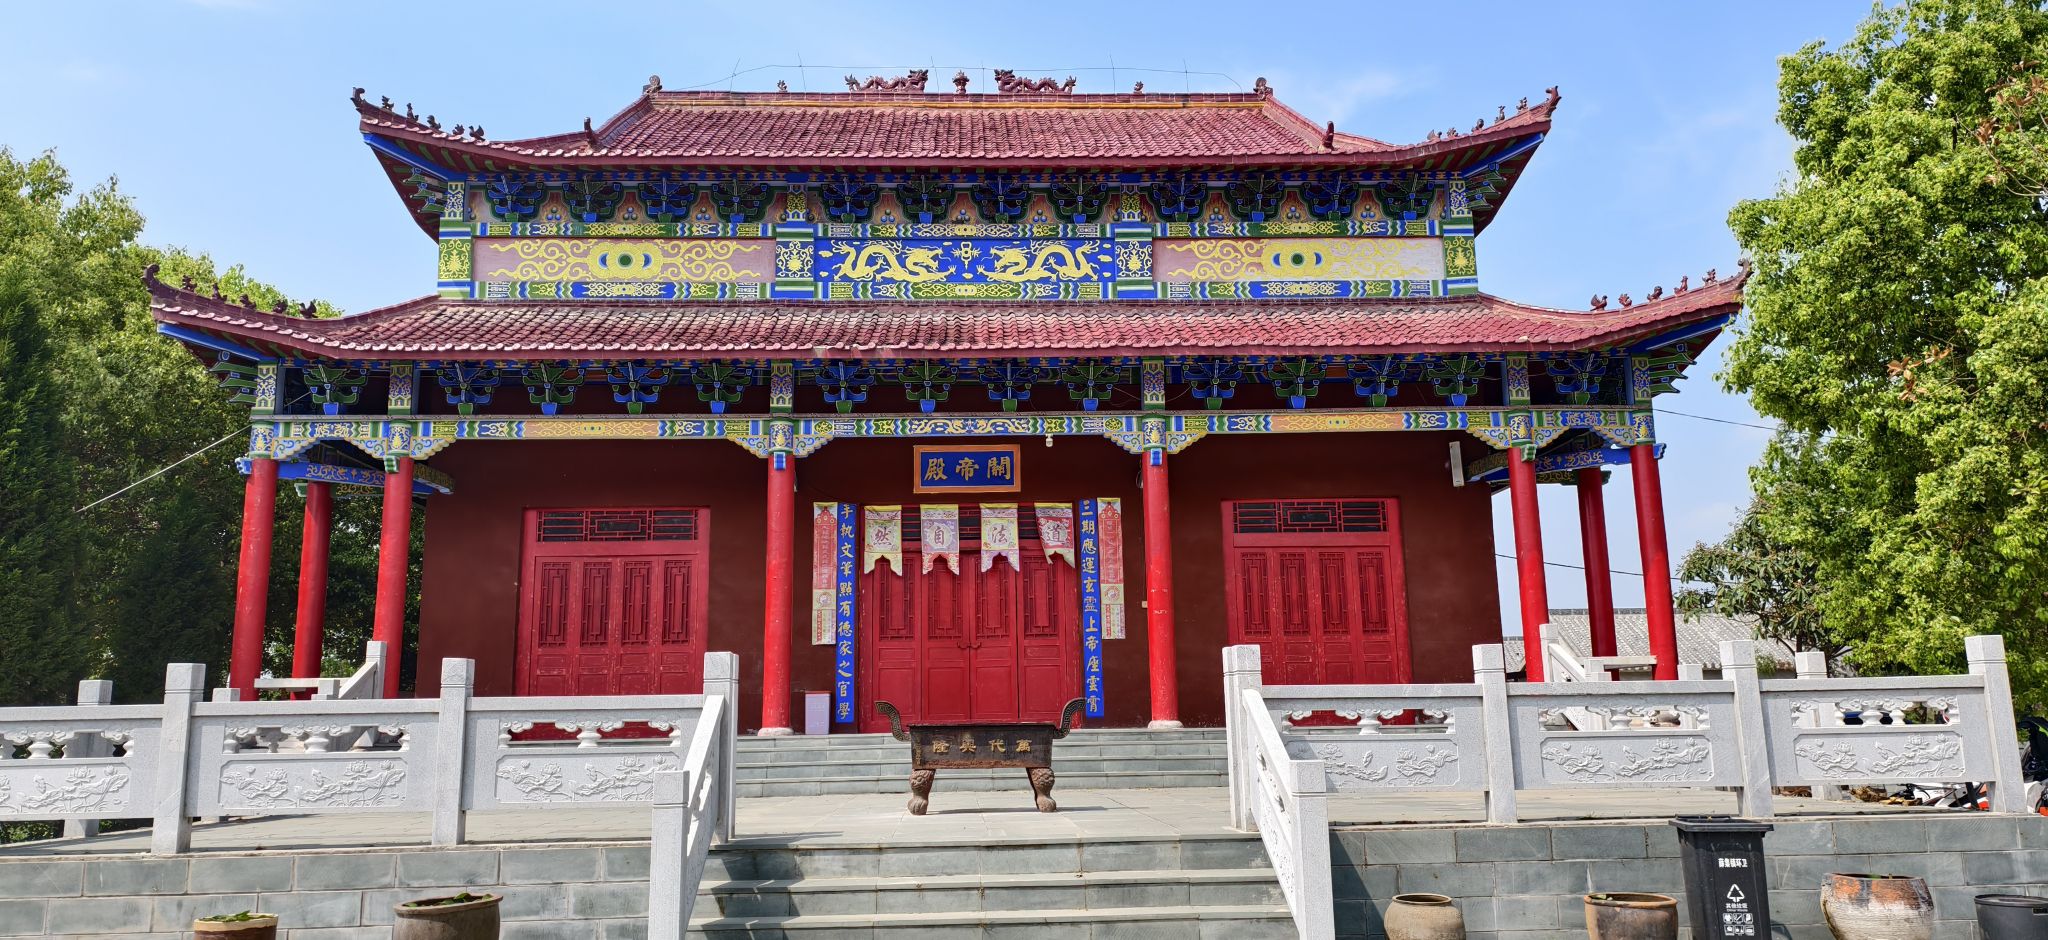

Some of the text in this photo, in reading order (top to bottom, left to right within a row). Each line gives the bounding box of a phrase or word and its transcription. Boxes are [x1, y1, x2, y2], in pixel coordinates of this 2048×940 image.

[873, 527, 892, 546] 然
[933, 526, 945, 545] 自
[991, 524, 1009, 544] 法
[1046, 525, 1065, 543] 道
